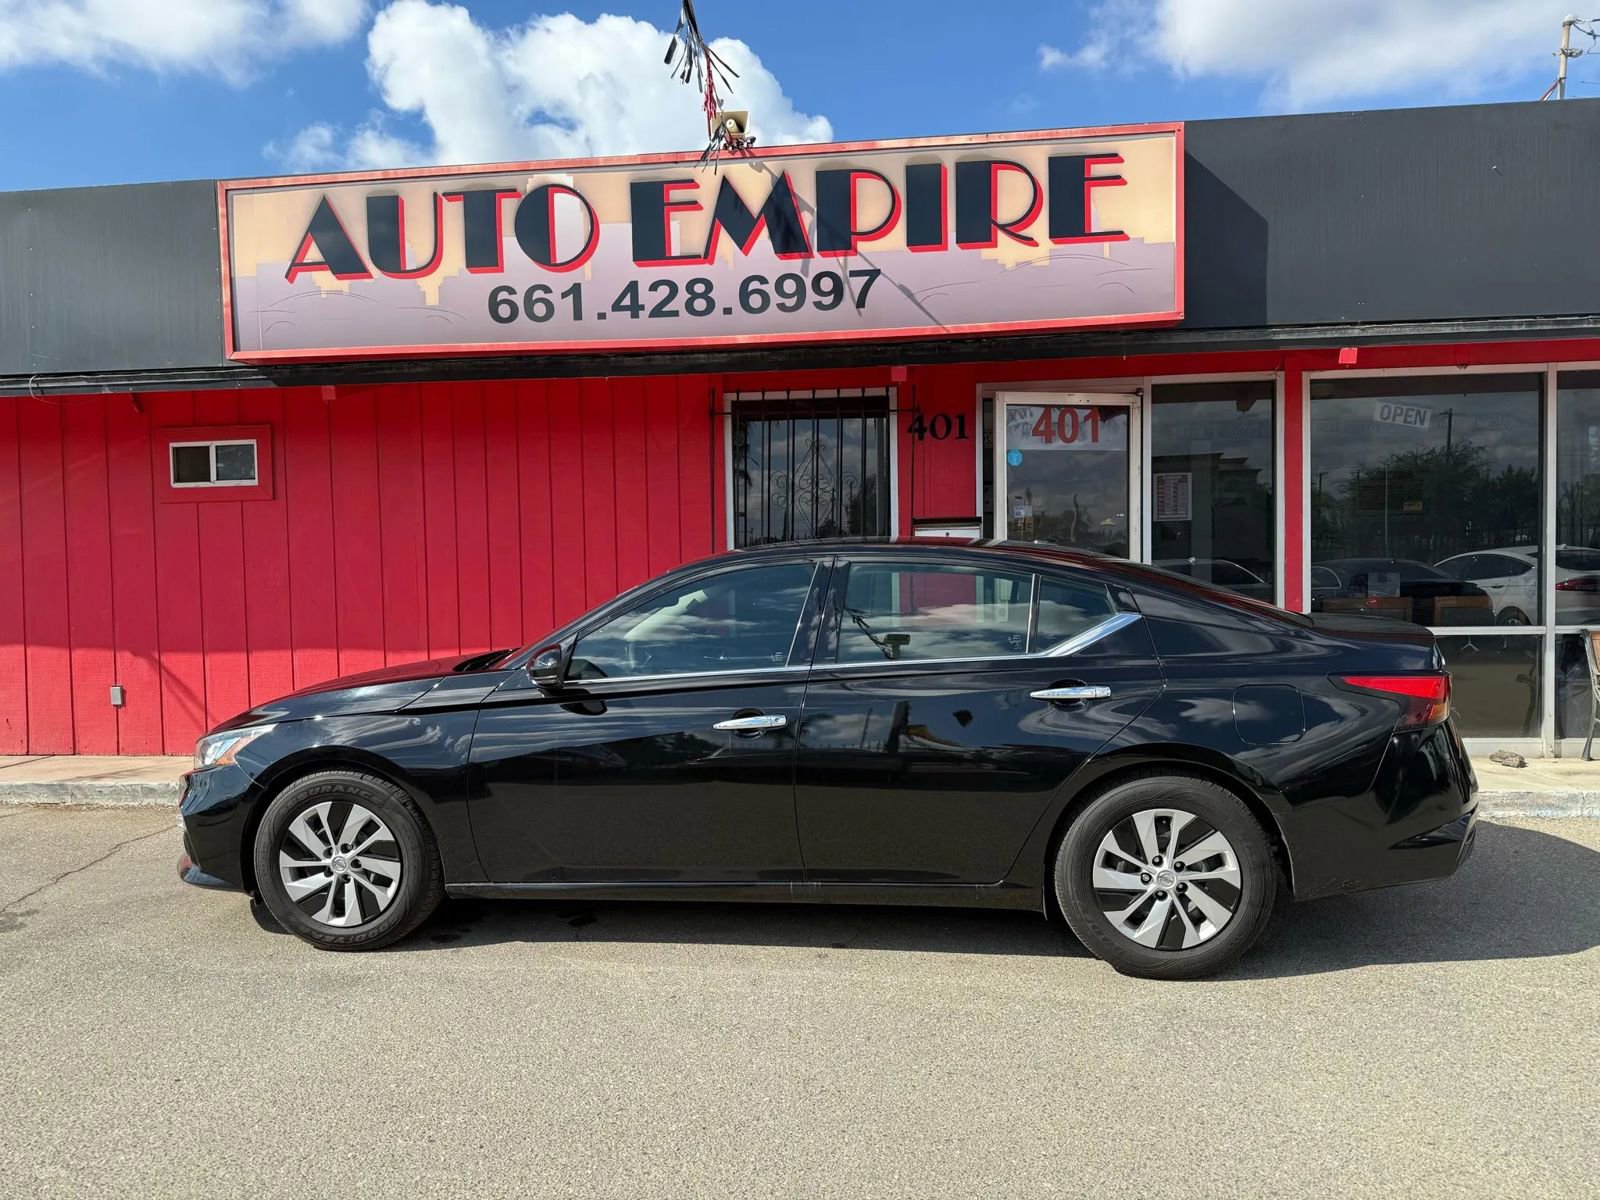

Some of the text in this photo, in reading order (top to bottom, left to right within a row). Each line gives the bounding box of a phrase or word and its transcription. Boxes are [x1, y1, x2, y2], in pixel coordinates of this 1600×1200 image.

[285, 152, 1130, 284] AUTO EMPIRE
[487, 269, 882, 324] 661.428.6997
[907, 413, 969, 441] 401
[1031, 405, 1100, 444] 401
[1380, 404, 1427, 427] OPEN
